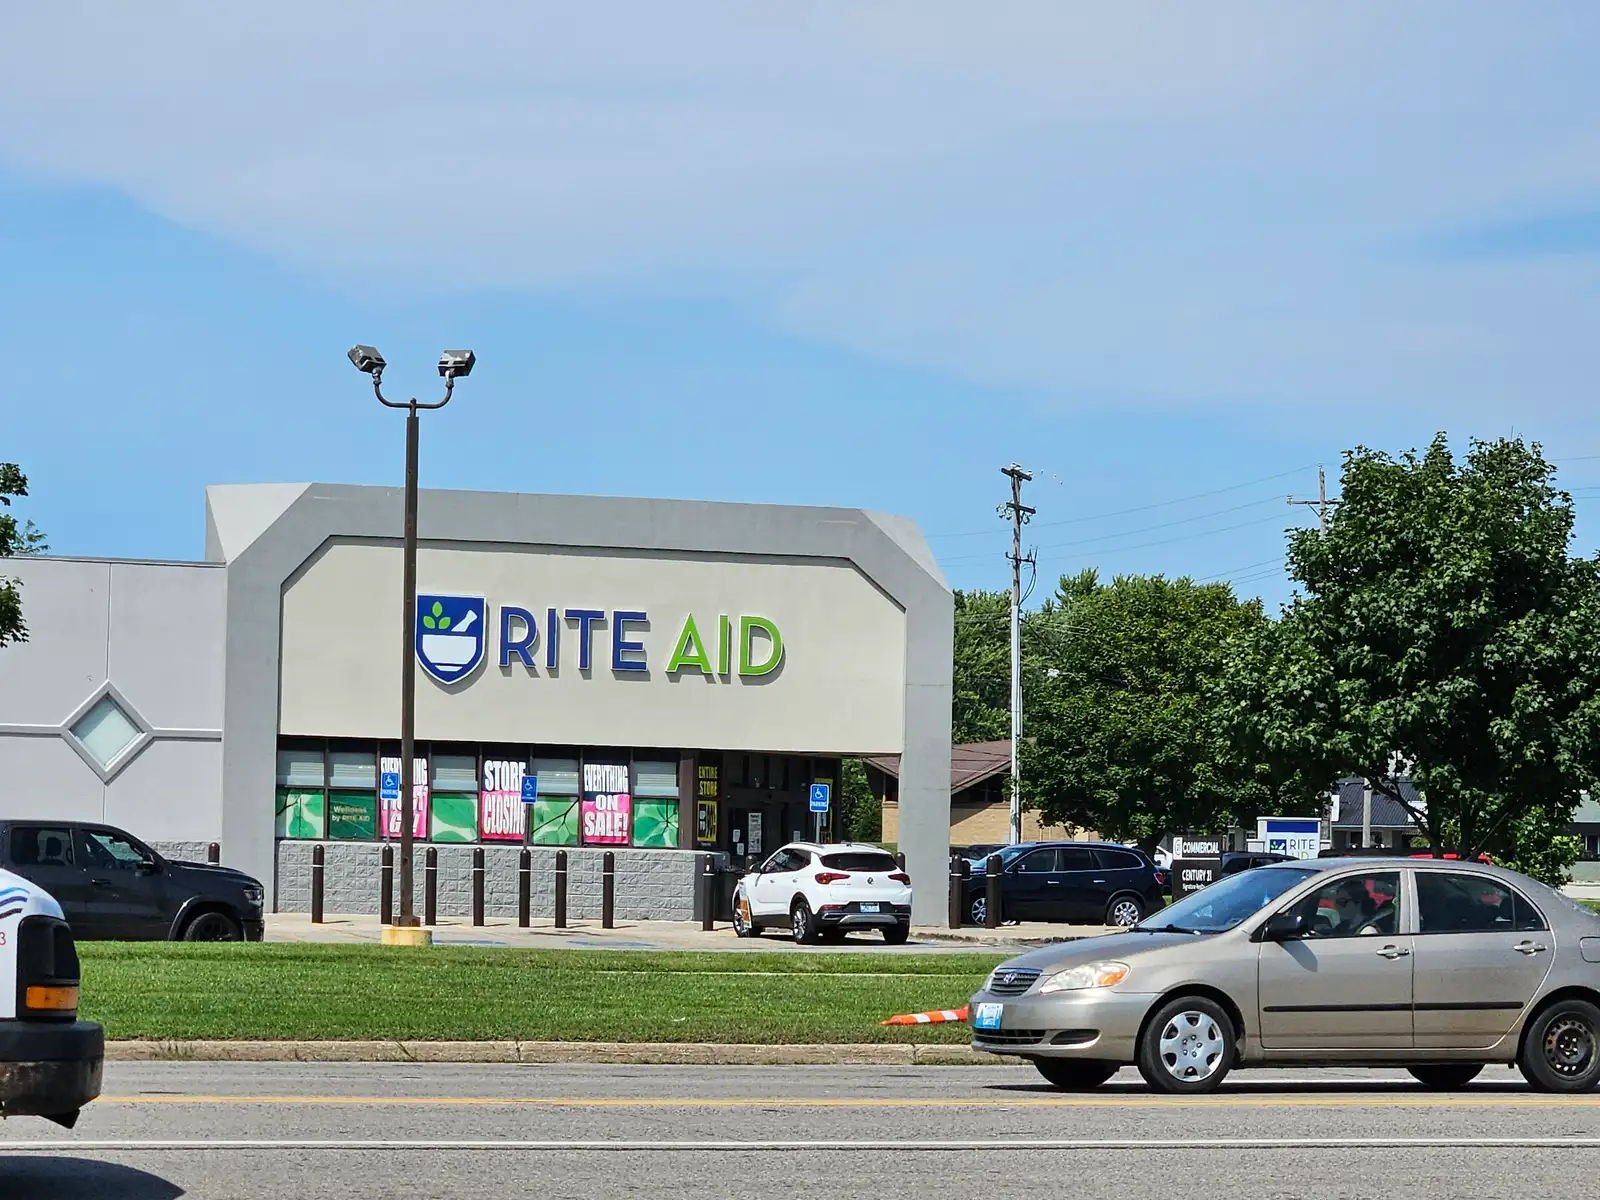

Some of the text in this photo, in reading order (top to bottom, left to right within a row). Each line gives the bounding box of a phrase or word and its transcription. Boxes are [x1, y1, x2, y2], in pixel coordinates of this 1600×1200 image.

[498, 605, 784, 676] RITE AID
[381, 757, 427, 785] EVERING
[584, 764, 628, 793] EVERYTHING
[699, 766, 718, 779] ENTIRE
[699, 781, 718, 796] STORE
[595, 794, 619, 811] ON
[389, 812, 420, 833] G!
[484, 793, 526, 835] CLOSING
[584, 811, 628, 837] SALE!
[1183, 841, 1220, 854] COMMERCIAL
[1290, 839, 1315, 850] RITE
[1182, 869, 1213, 881] CENTURY 21
